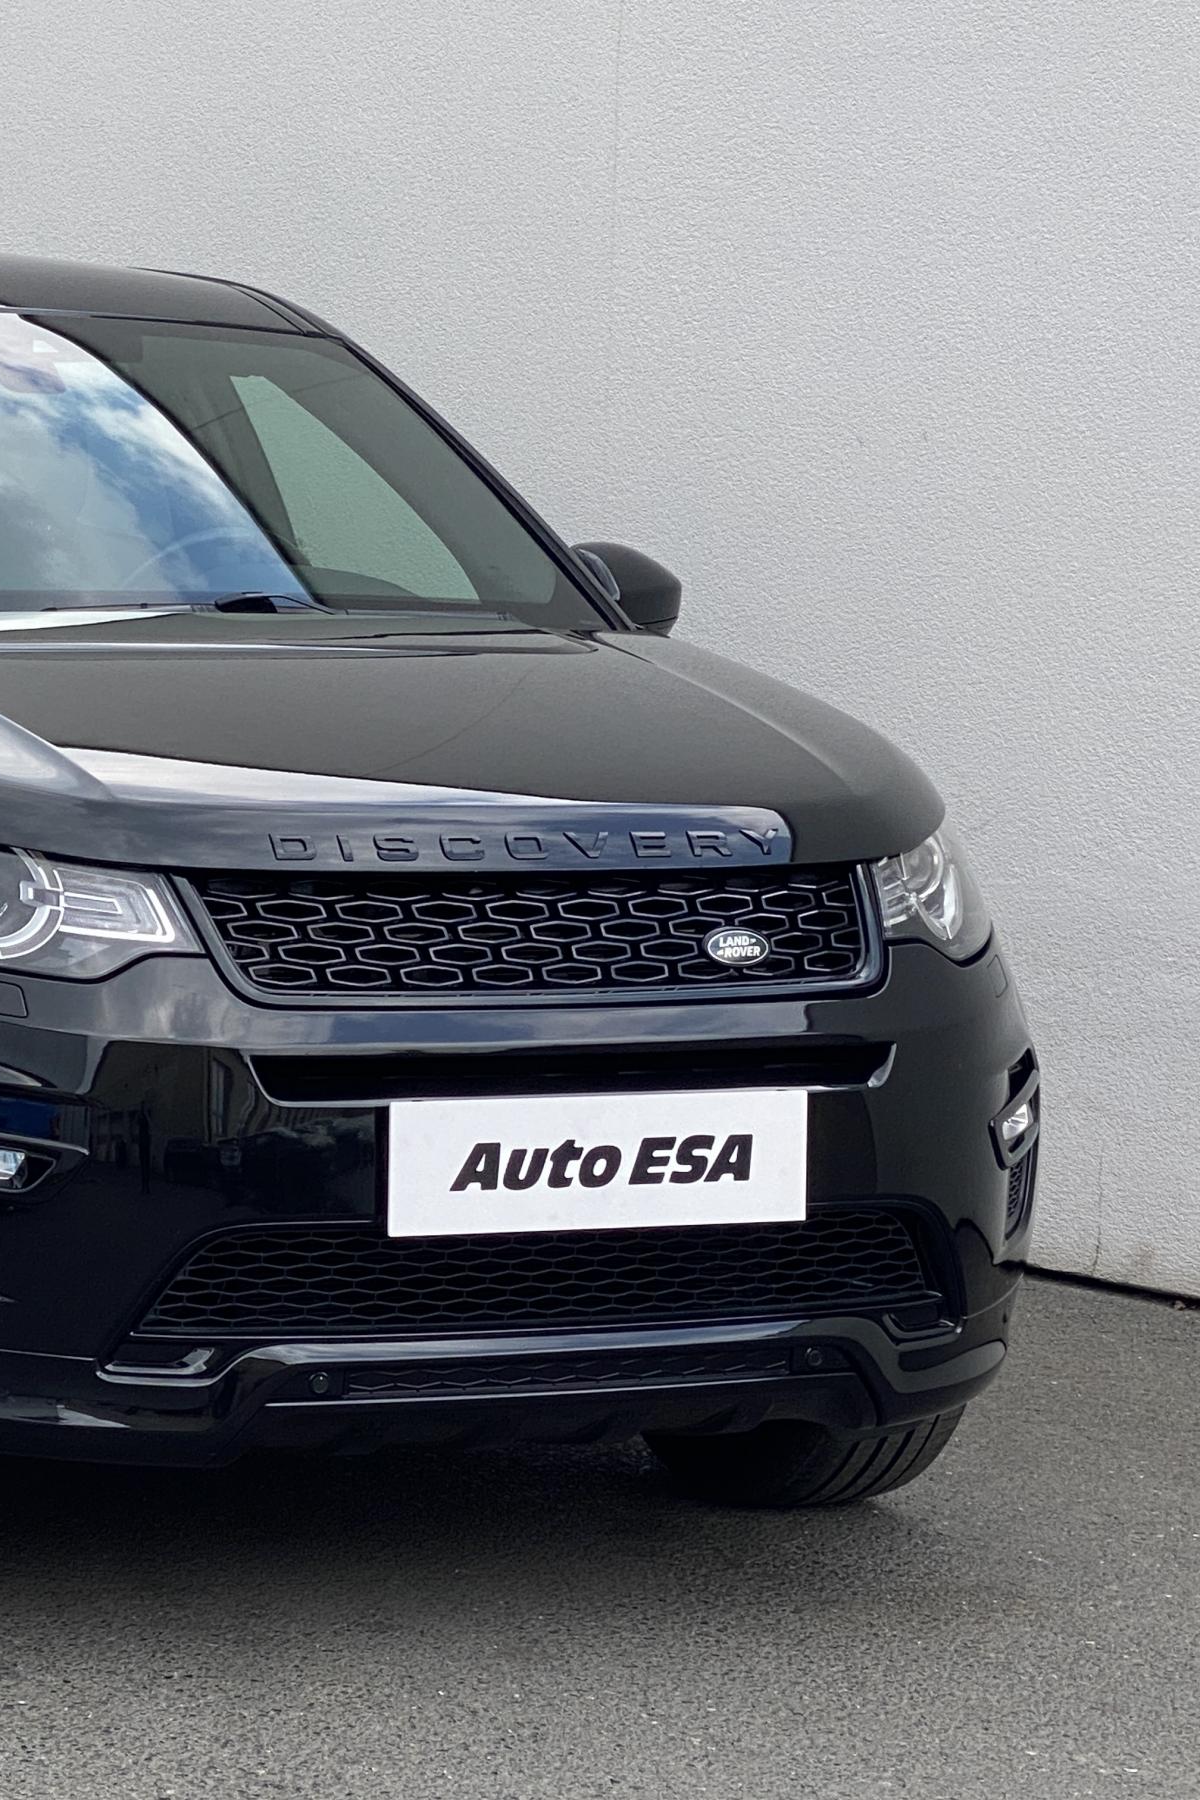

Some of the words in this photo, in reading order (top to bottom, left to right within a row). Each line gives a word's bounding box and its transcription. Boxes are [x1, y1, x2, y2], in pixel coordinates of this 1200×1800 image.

[269, 828, 779, 862] DISCOVERY
[719, 936, 750, 948] LAND
[724, 946, 761, 958] ROVER
[449, 1139, 621, 1191] Auto
[628, 1134, 753, 1185] ESA
